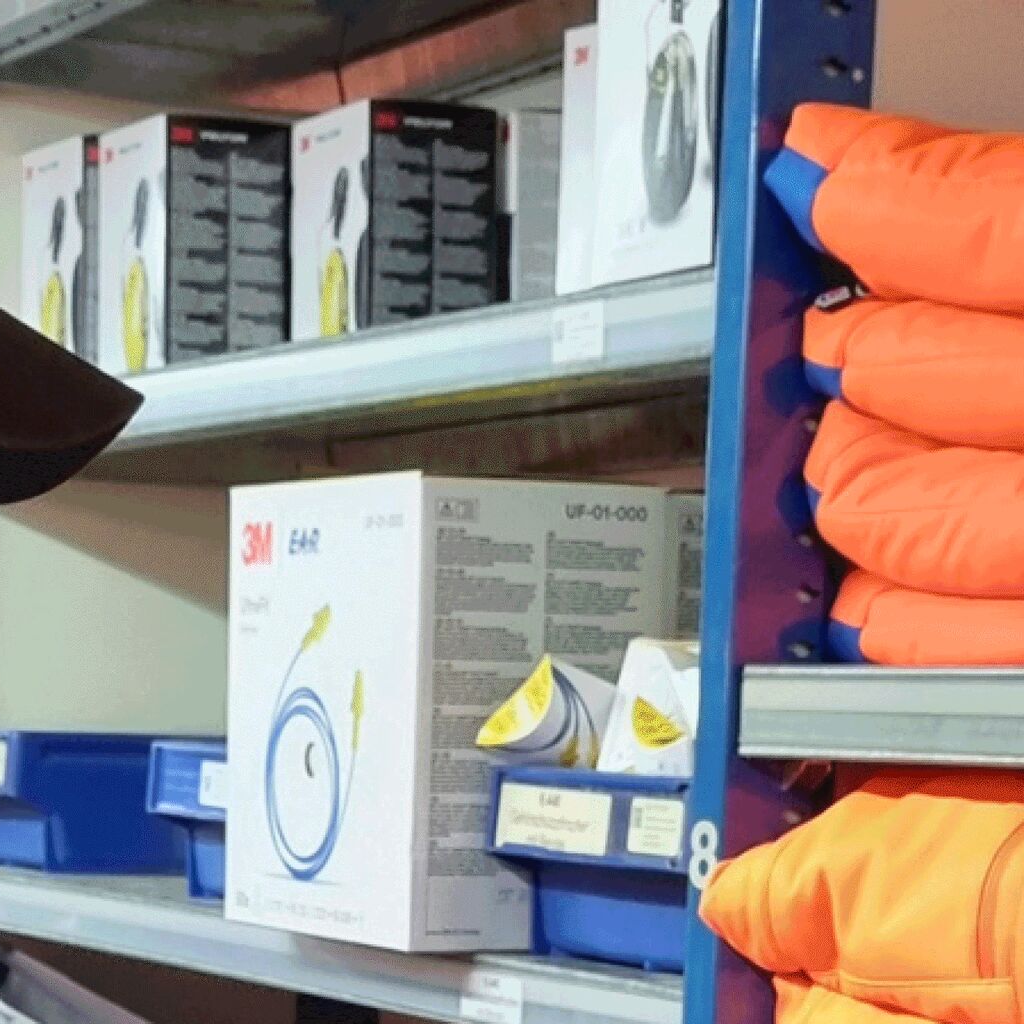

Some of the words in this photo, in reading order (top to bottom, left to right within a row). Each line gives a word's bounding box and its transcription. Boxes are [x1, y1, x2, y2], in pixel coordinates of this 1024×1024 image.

[564, 503, 649, 523] UF-01-000
[240, 521, 273, 567] 3M
[689, 820, 718, 891] 8
